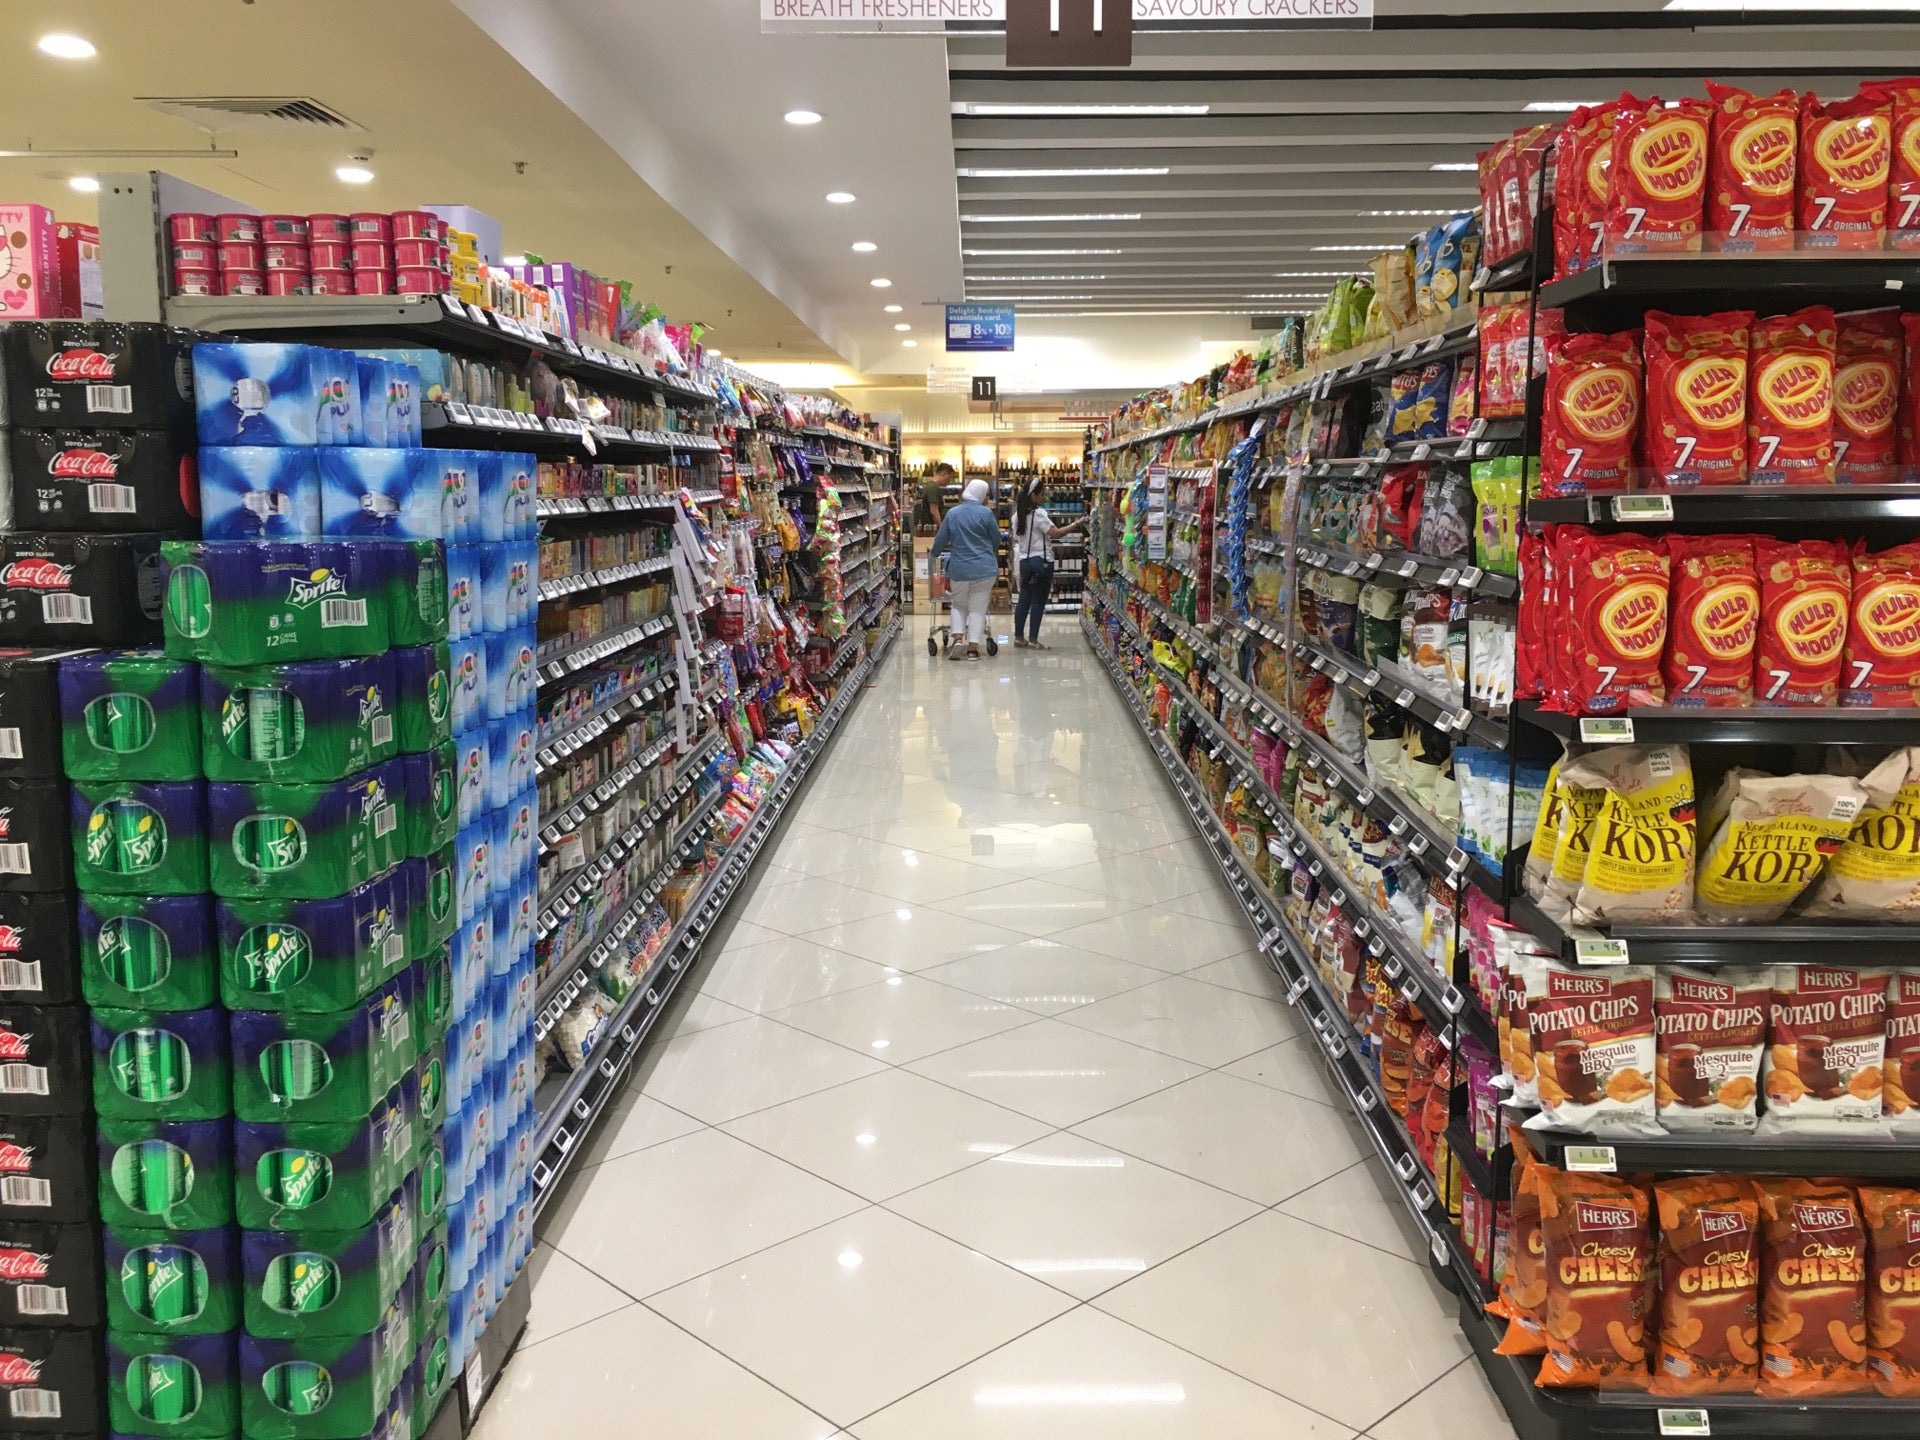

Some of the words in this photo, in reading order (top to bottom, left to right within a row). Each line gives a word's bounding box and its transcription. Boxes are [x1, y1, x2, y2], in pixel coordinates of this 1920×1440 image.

[774, 0, 852, 17] BREATH
[862, 0, 993, 17] FRESHENERS
[1137, 0, 1239, 16] SAVOURY
[1249, 0, 1359, 16] CRACKERS
[1643, 131, 1692, 168] HULA
[1744, 130, 1790, 165] HULA
[1828, 126, 1878, 160] HULA
[1623, 207, 1647, 240] 7
[1729, 204, 1751, 237] 7
[1811, 196, 1836, 230] 7
[1834, 221, 1872, 231] ORIGINAL
[46, 352, 120, 376] Coca-Cola
[34, 388, 46, 398] 12
[978, 382, 991, 396] 11
[1576, 378, 1622, 412] HULA
[1690, 368, 1737, 400] HULA
[1772, 365, 1820, 398] HULA
[1840, 372, 1886, 404] HULA
[48, 451, 122, 474] Coca-Cola
[1562, 448, 1584, 479] 7
[1584, 468, 1620, 479] ORIGINAL
[1674, 436, 1697, 469] 7
[1696, 458, 1734, 470] ORIGINAL
[1758, 435, 1782, 469] 7
[1780, 458, 1820, 468] ORIGINAL
[37, 488, 48, 498] 12
[0, 562, 76, 586] Coca-Cola
[294, 576, 341, 602] Sprite
[1614, 595, 1656, 630] HULA
[1706, 596, 1748, 630] HULA
[1790, 602, 1835, 635] HULA
[1872, 594, 1920, 626] HULA
[266, 636, 280, 647] 12
[1596, 666, 1618, 694] 7
[1682, 665, 1708, 694] 7
[1765, 669, 1791, 700] 7
[1850, 660, 1874, 688] 7
[1650, 752, 1670, 760] 100%
[1837, 800, 1856, 808] 100%
[1736, 832, 1812, 852] KETTLE
[265, 936, 299, 979] Sprite
[1554, 978, 1604, 994] HERR'S
[1678, 982, 1728, 1000] HERR'S
[1804, 971, 1852, 988] HERR'S
[1528, 1004, 1585, 1036] POTATO
[1590, 996, 1639, 1024] CHIPS
[1657, 1012, 1708, 1035] OTATO
[1712, 1006, 1764, 1031] CHIPS
[1770, 1001, 1835, 1028] POTATO
[1840, 992, 1886, 1020] CHIPS
[1580, 1043, 1636, 1062] Mesquite
[1694, 1052, 1754, 1067] Mesquite
[1824, 1041, 1880, 1058] Mesquite
[1825, 1056, 1856, 1070] BBQ
[1584, 1058, 1613, 1074] BBQ
[286, 1156, 320, 1202] Sprite
[1583, 1210, 1630, 1226] HERR'S
[1800, 1208, 1846, 1226] HERR'S
[1580, 1242, 1636, 1262] Cheesy
[292, 1264, 324, 1306] Sprite
